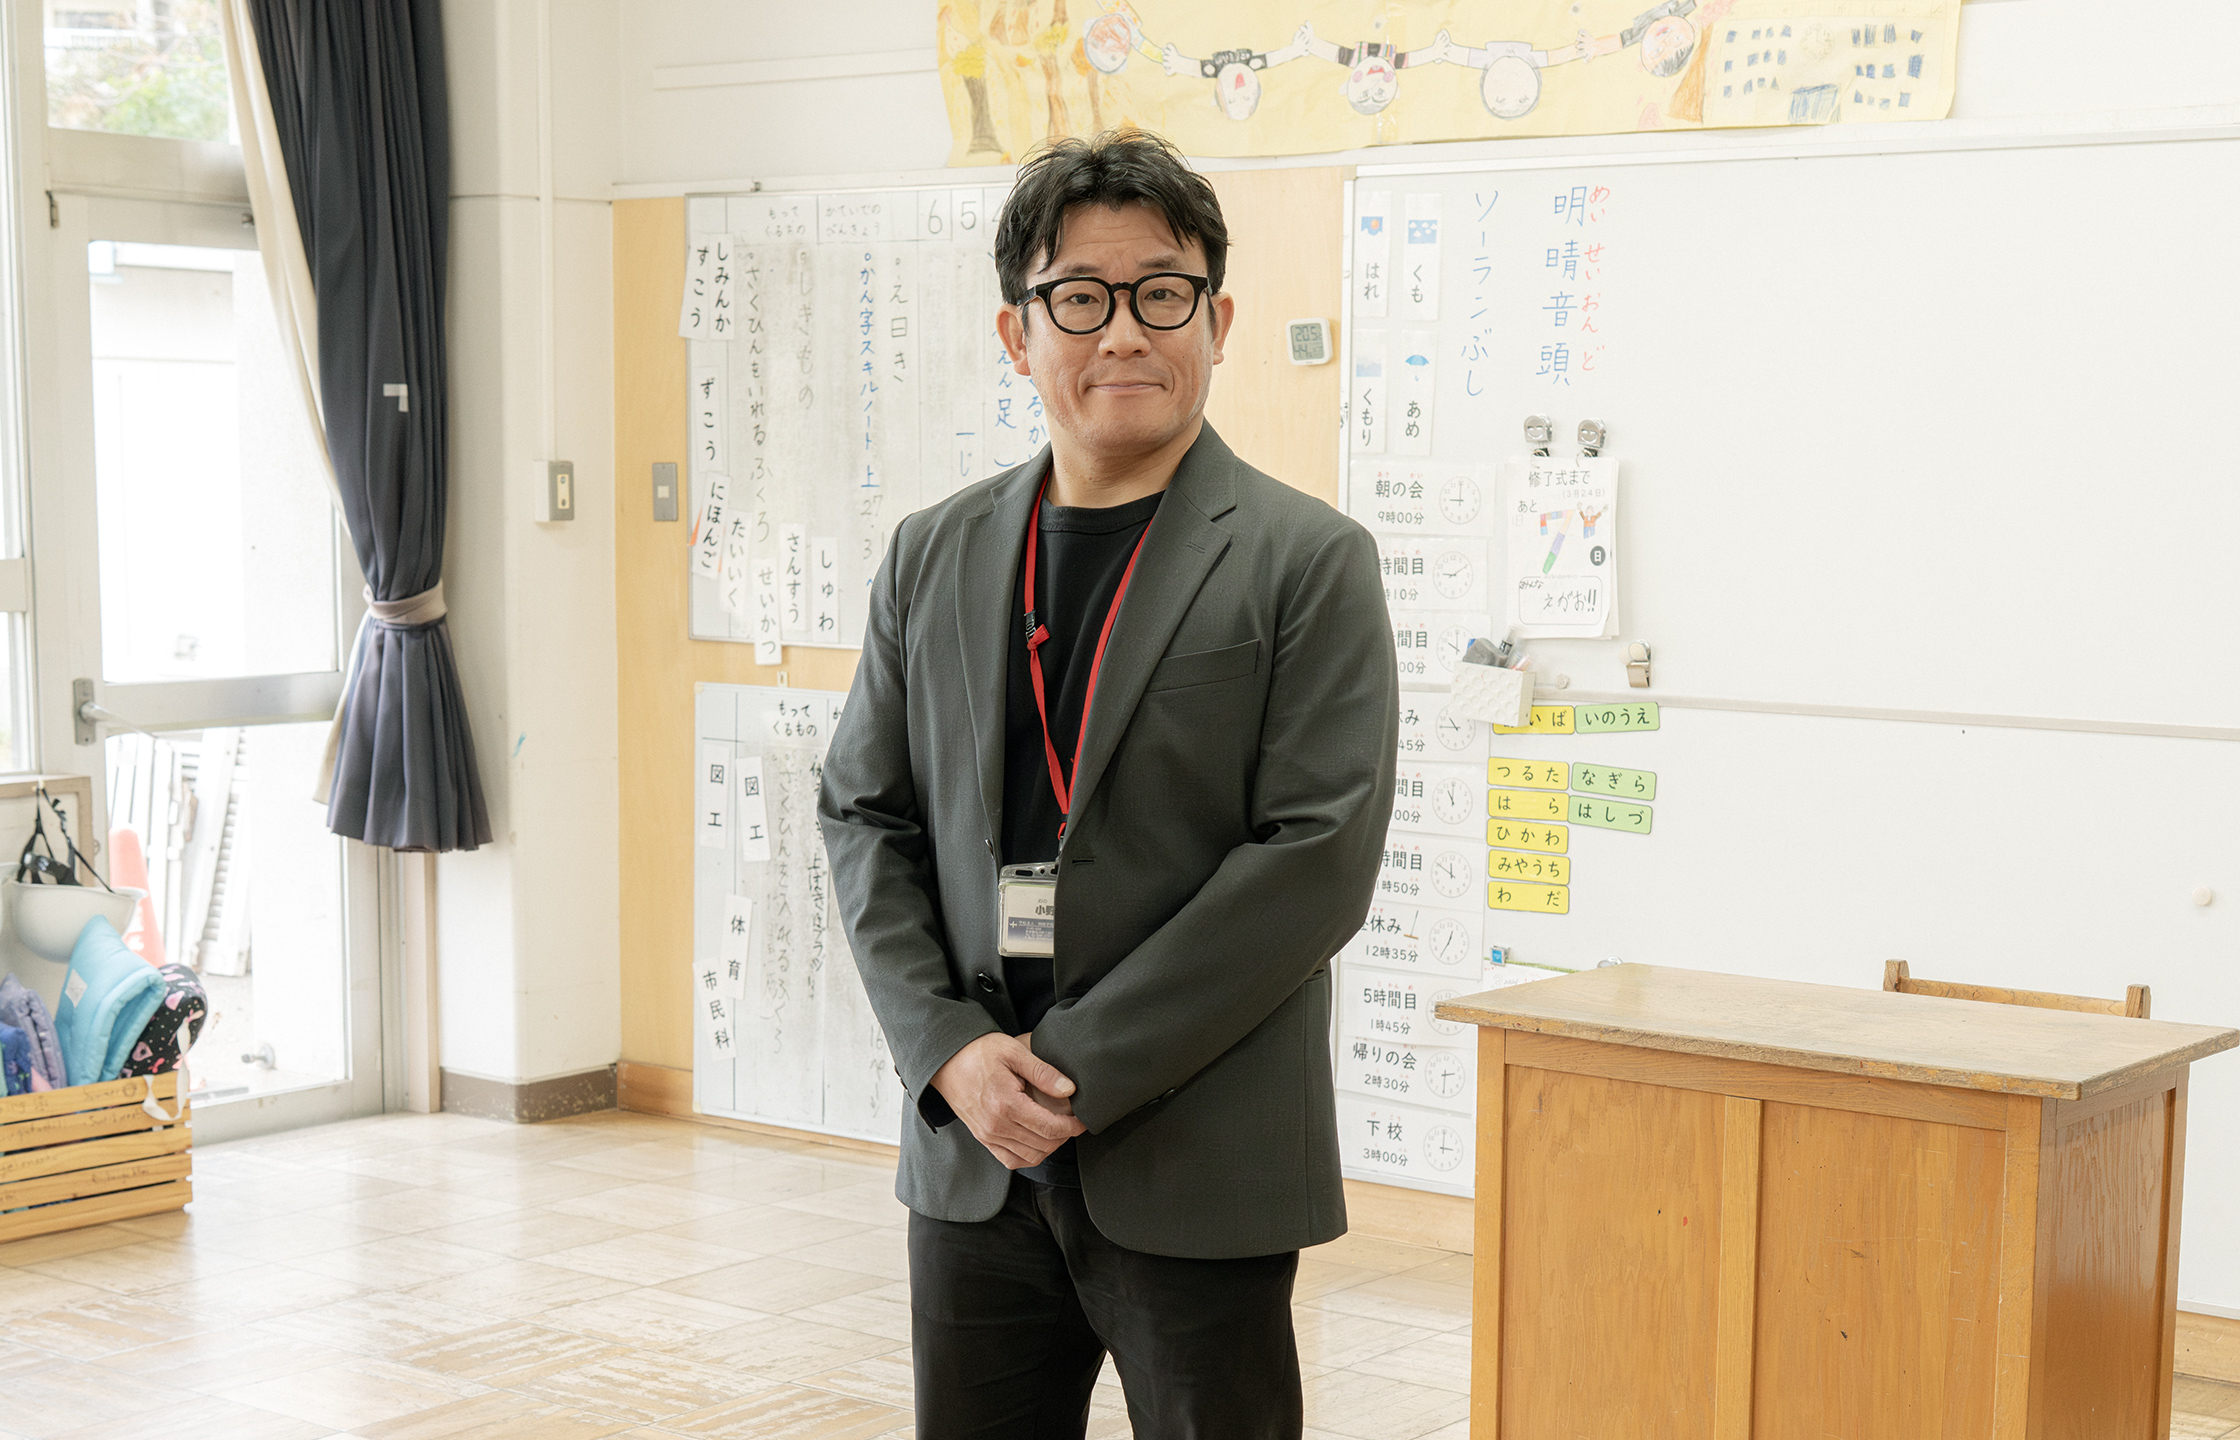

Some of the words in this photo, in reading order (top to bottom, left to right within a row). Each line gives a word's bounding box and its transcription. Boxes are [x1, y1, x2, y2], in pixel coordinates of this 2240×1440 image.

[928, 199, 944, 234] 6
[960, 201, 977, 230] 5
[691, 246, 709, 329] すこう
[714, 242, 731, 333] しみんか
[1364, 262, 1380, 300] はれ
[1411, 264, 1424, 304] くも
[1461, 189, 1500, 397] ソーランぶし
[1536, 186, 1587, 386] 明晴音頭
[859, 267, 881, 487] かん字スキルノート上
[700, 377, 716, 461] ずこう
[1361, 388, 1374, 447] くもり
[1405, 400, 1421, 439] あめ
[1375, 479, 1425, 500] 朝の会
[1528, 470, 1590, 487] 修了式まで
[1377, 510, 1425, 526] 9時00分
[1517, 499, 1538, 513] あと
[701, 481, 725, 569] にほんご
[727, 517, 746, 608] たいいく
[1594, 549, 1603, 563] 日
[786, 532, 802, 624] さんすう
[818, 550, 834, 632] しゅわ
[757, 566, 777, 655] せいかつ
[778, 701, 811, 718] もって
[1585, 707, 1651, 726] いのうえ
[773, 721, 818, 738] くるもの
[1497, 765, 1560, 783] つるた
[1581, 768, 1647, 793] なぎら
[707, 764, 725, 827] 図工
[744, 776, 764, 841] 図工
[1497, 796, 1561, 815] はら
[1578, 803, 1645, 825] はしづ
[1496, 828, 1561, 847] ひかわ
[1497, 857, 1561, 878] みやうち
[1497, 888, 1562, 907] わだ
[1361, 914, 1402, 935] 休み
[727, 914, 746, 981] 体育
[1365, 944, 1418, 963] 12時35分
[702, 969, 731, 1050] 市民科
[1363, 986, 1417, 1010] 5時間目
[1370, 1018, 1411, 1035] 1時45分
[1352, 1041, 1417, 1071] 帰りの会
[1364, 1073, 1410, 1093] 2時30分
[1366, 1119, 1403, 1142] 下校
[1363, 1147, 1408, 1167] 3時00分
